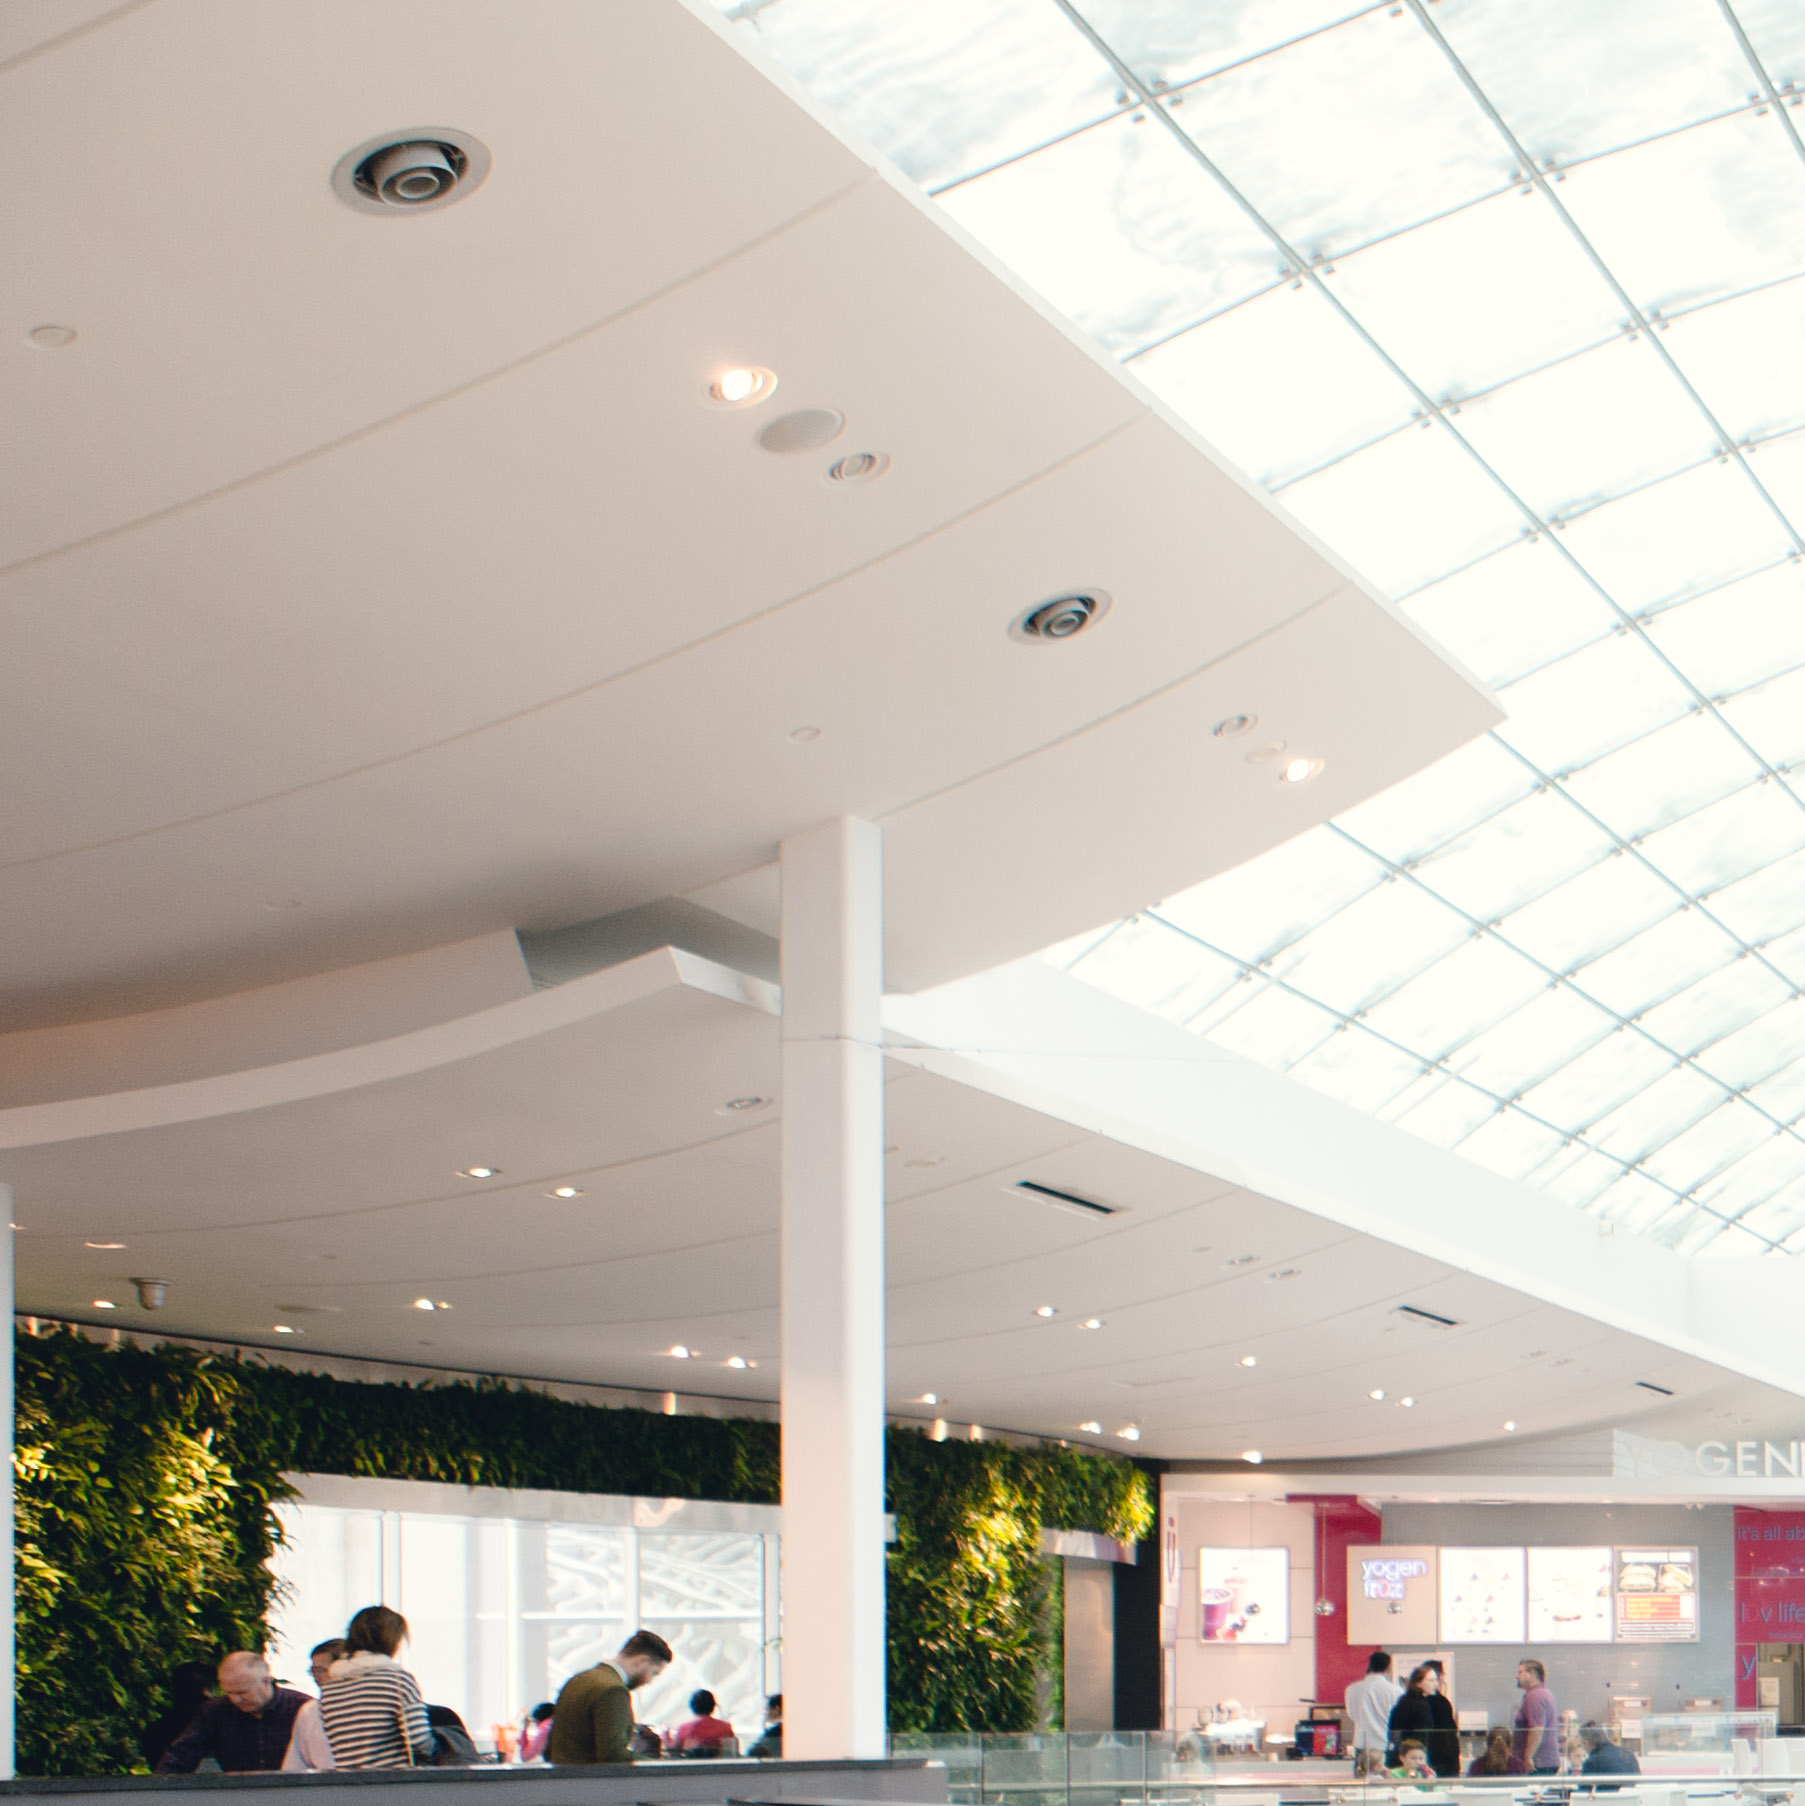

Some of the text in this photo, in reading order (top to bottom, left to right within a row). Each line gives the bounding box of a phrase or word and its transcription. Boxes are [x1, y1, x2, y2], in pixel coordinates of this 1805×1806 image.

[1620, 1440, 1802, 1478] YOGEN
[1764, 1526, 1781, 1541] all
[1361, 1558, 1428, 1581] yogen
